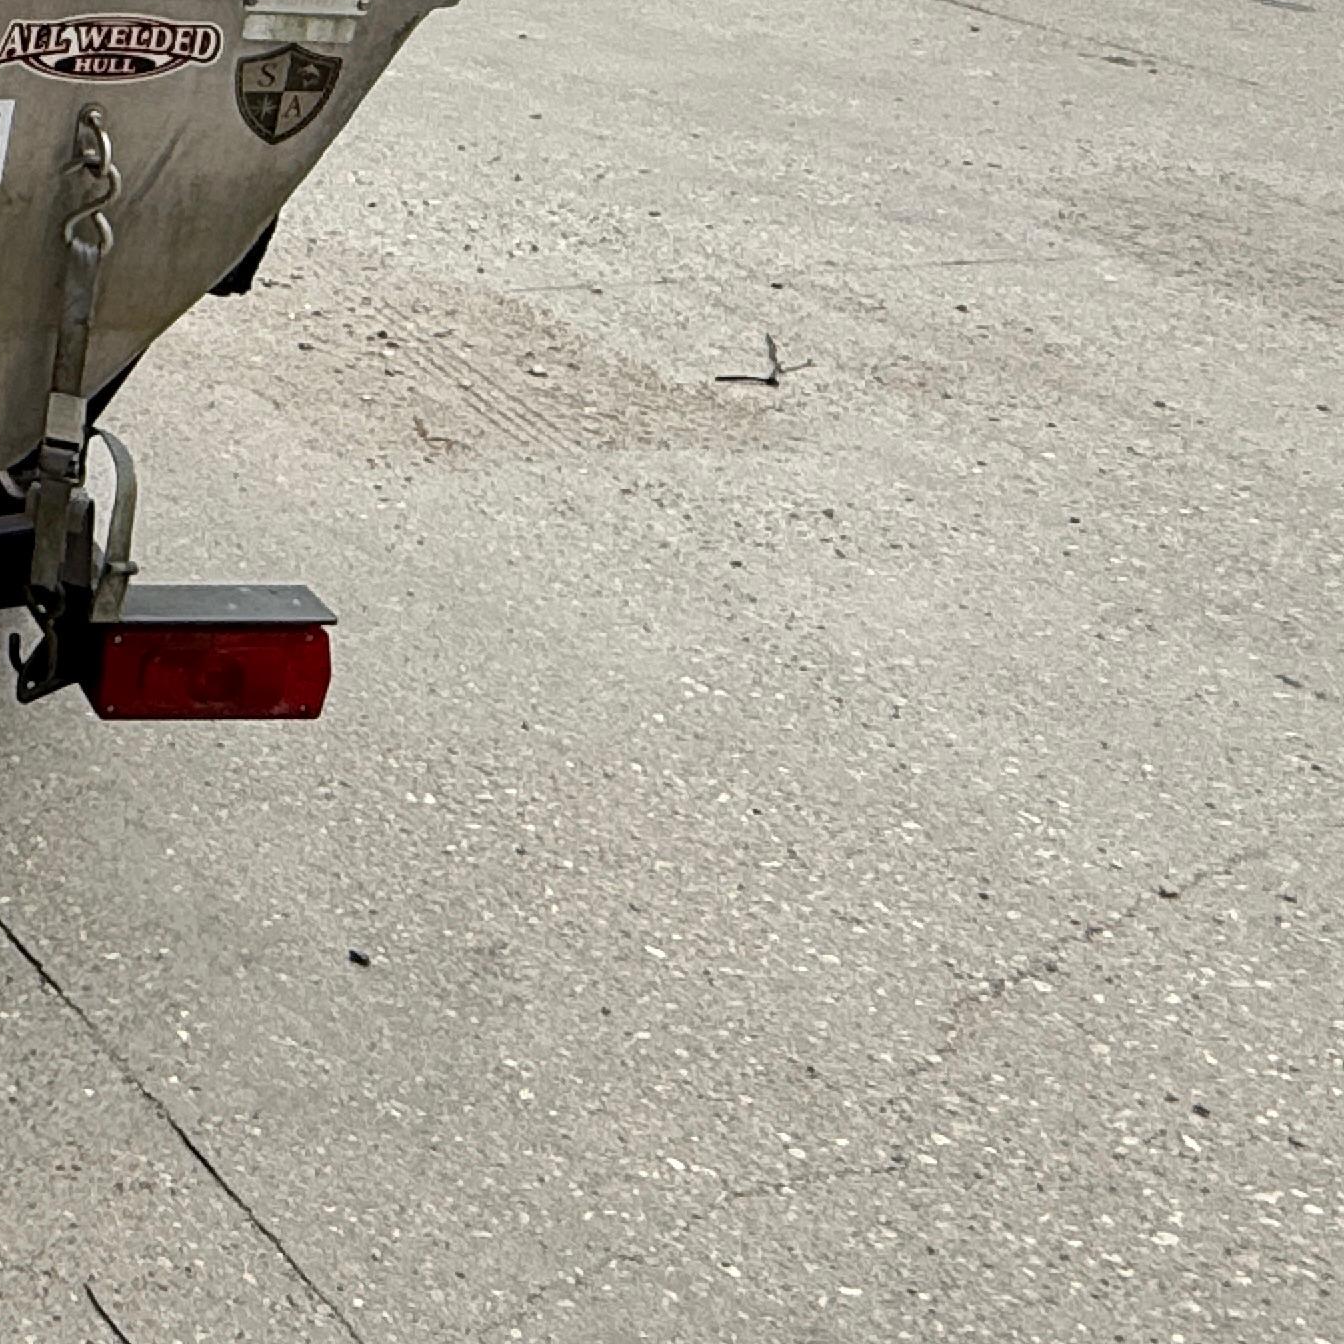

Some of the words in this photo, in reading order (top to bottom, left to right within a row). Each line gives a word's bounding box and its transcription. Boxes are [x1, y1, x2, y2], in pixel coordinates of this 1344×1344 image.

[77, 23, 219, 62] WELDED
[73, 57, 136, 73] HULL
[256, 61, 278, 88] S
[281, 94, 302, 118] A
